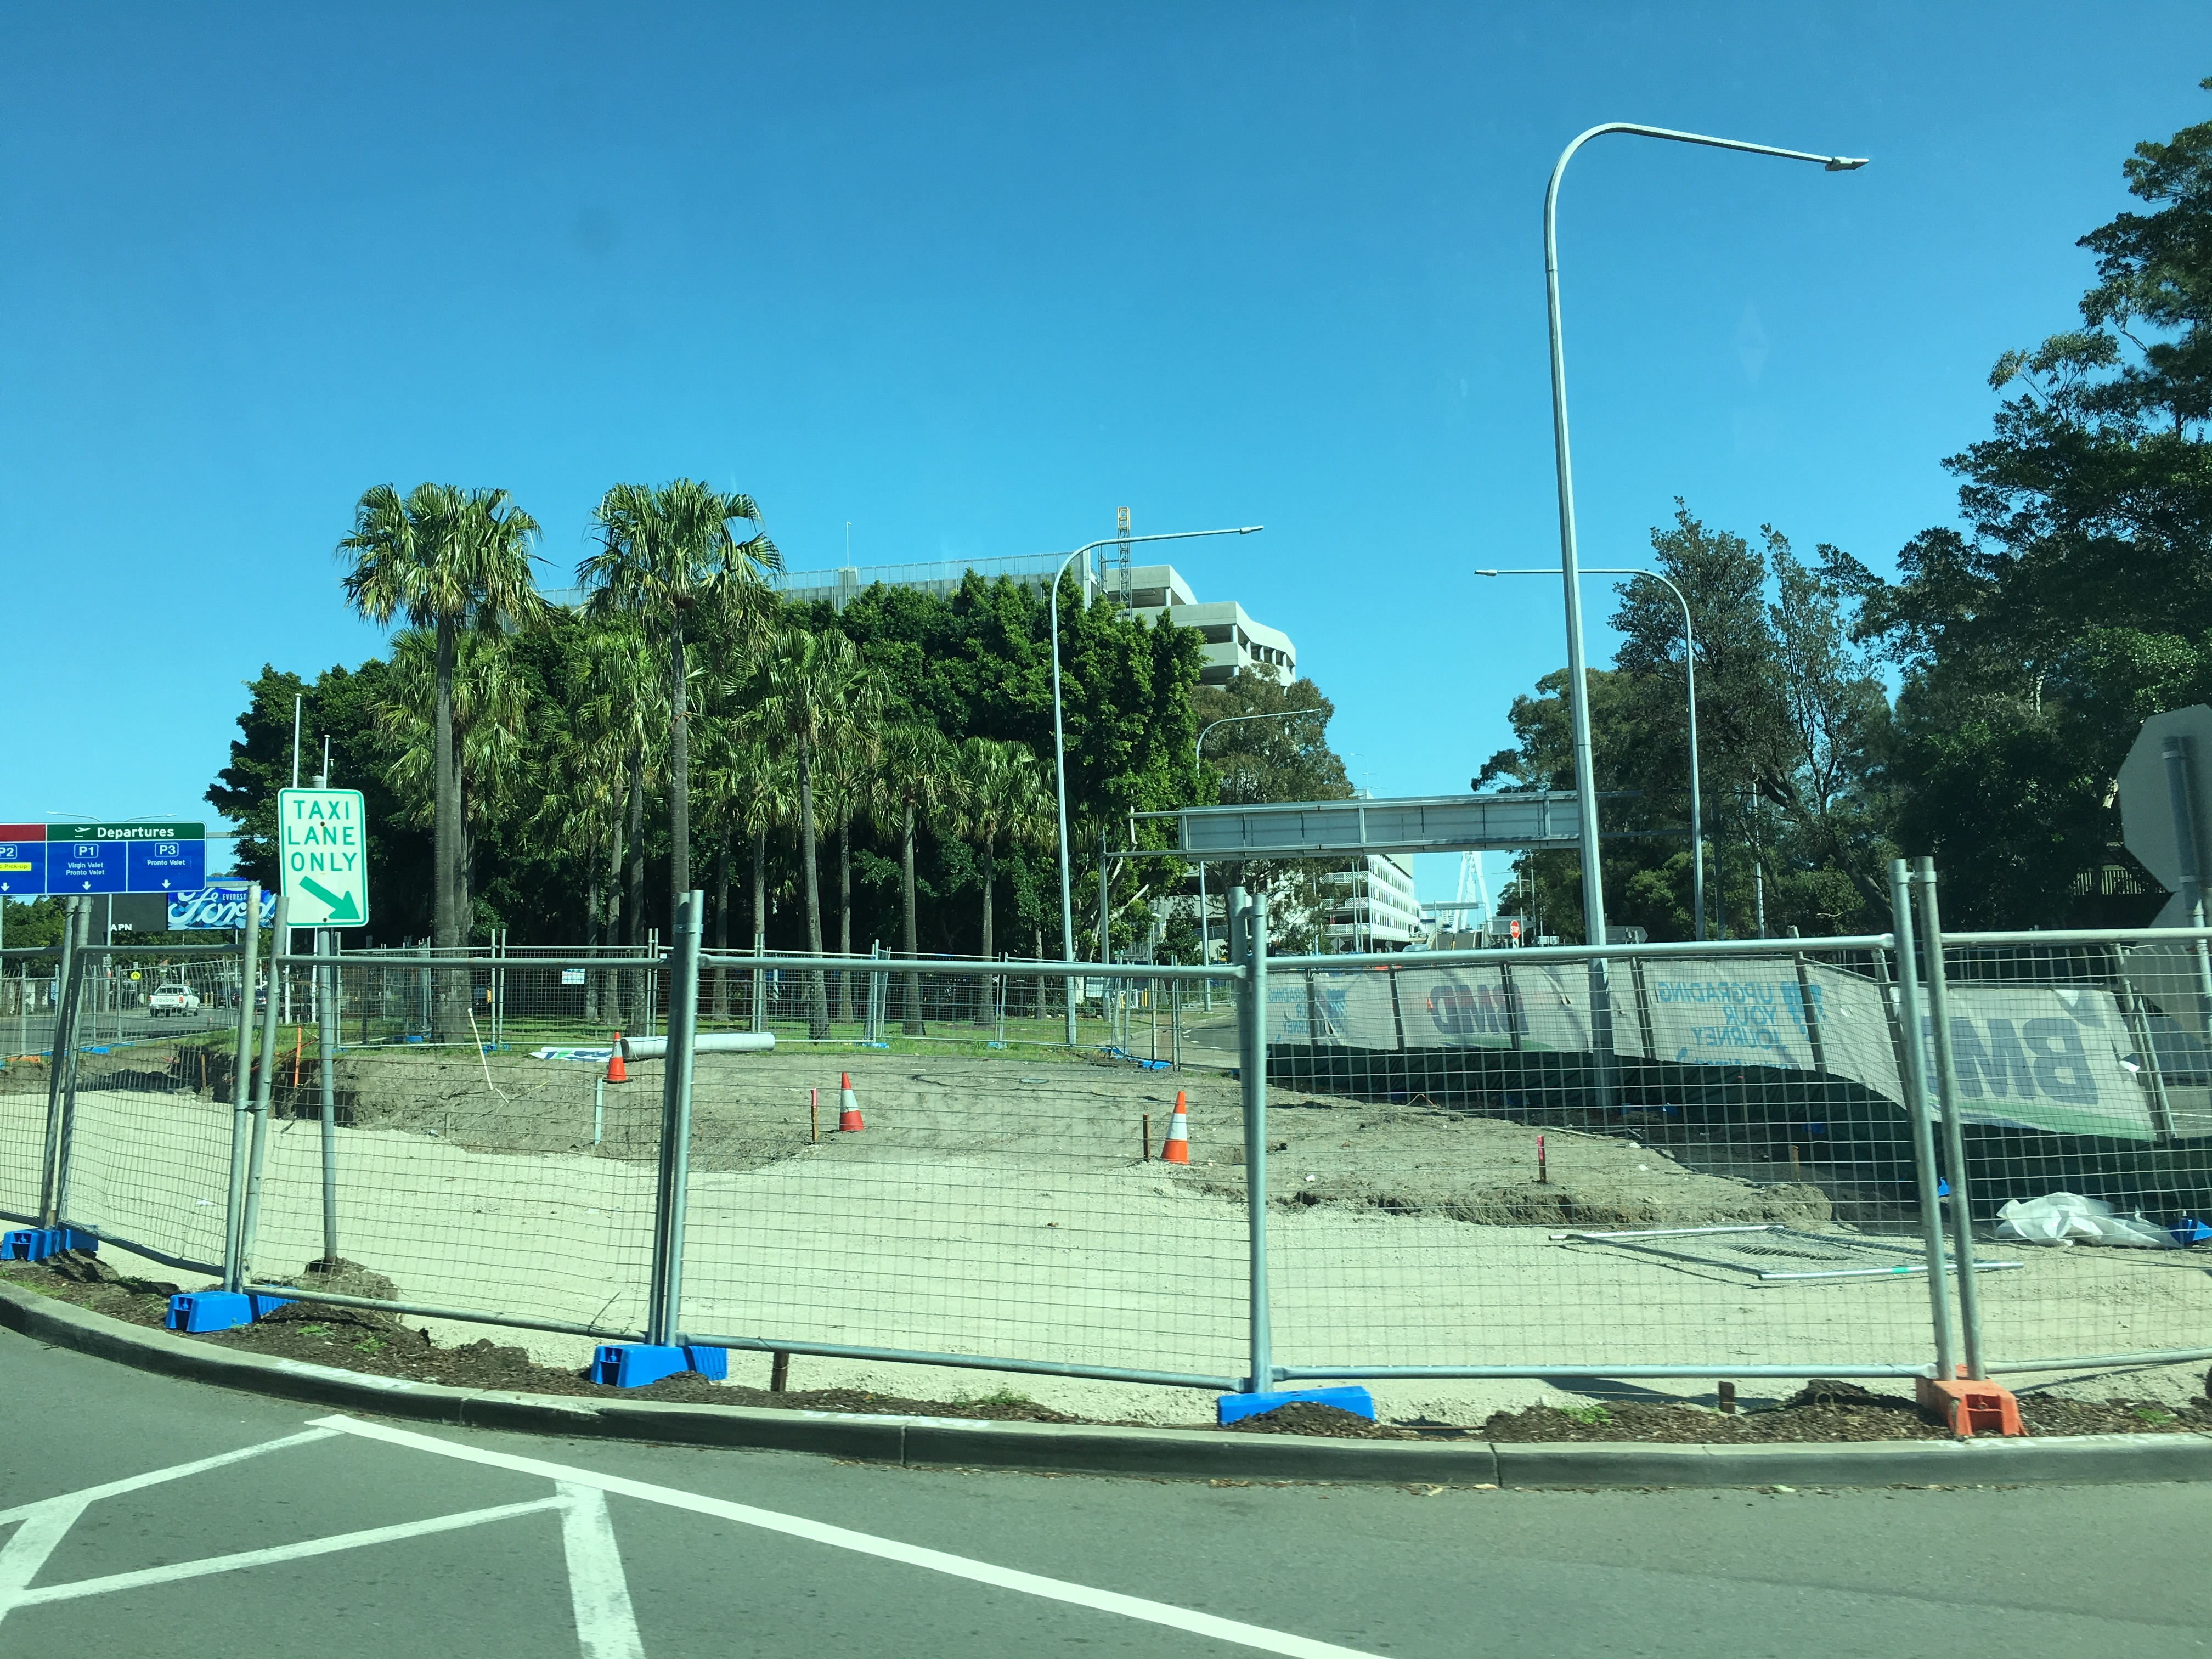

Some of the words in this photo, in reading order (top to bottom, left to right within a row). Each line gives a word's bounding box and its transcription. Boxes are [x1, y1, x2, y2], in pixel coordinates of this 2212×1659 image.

[293, 800, 349, 820] TAXI
[97, 827, 174, 839] Departures
[287, 826, 355, 845] LANE
[78, 846, 94, 856] P1
[159, 845, 176, 855] P3
[291, 851, 358, 871] ONLY
[110, 923, 132, 932] APN
